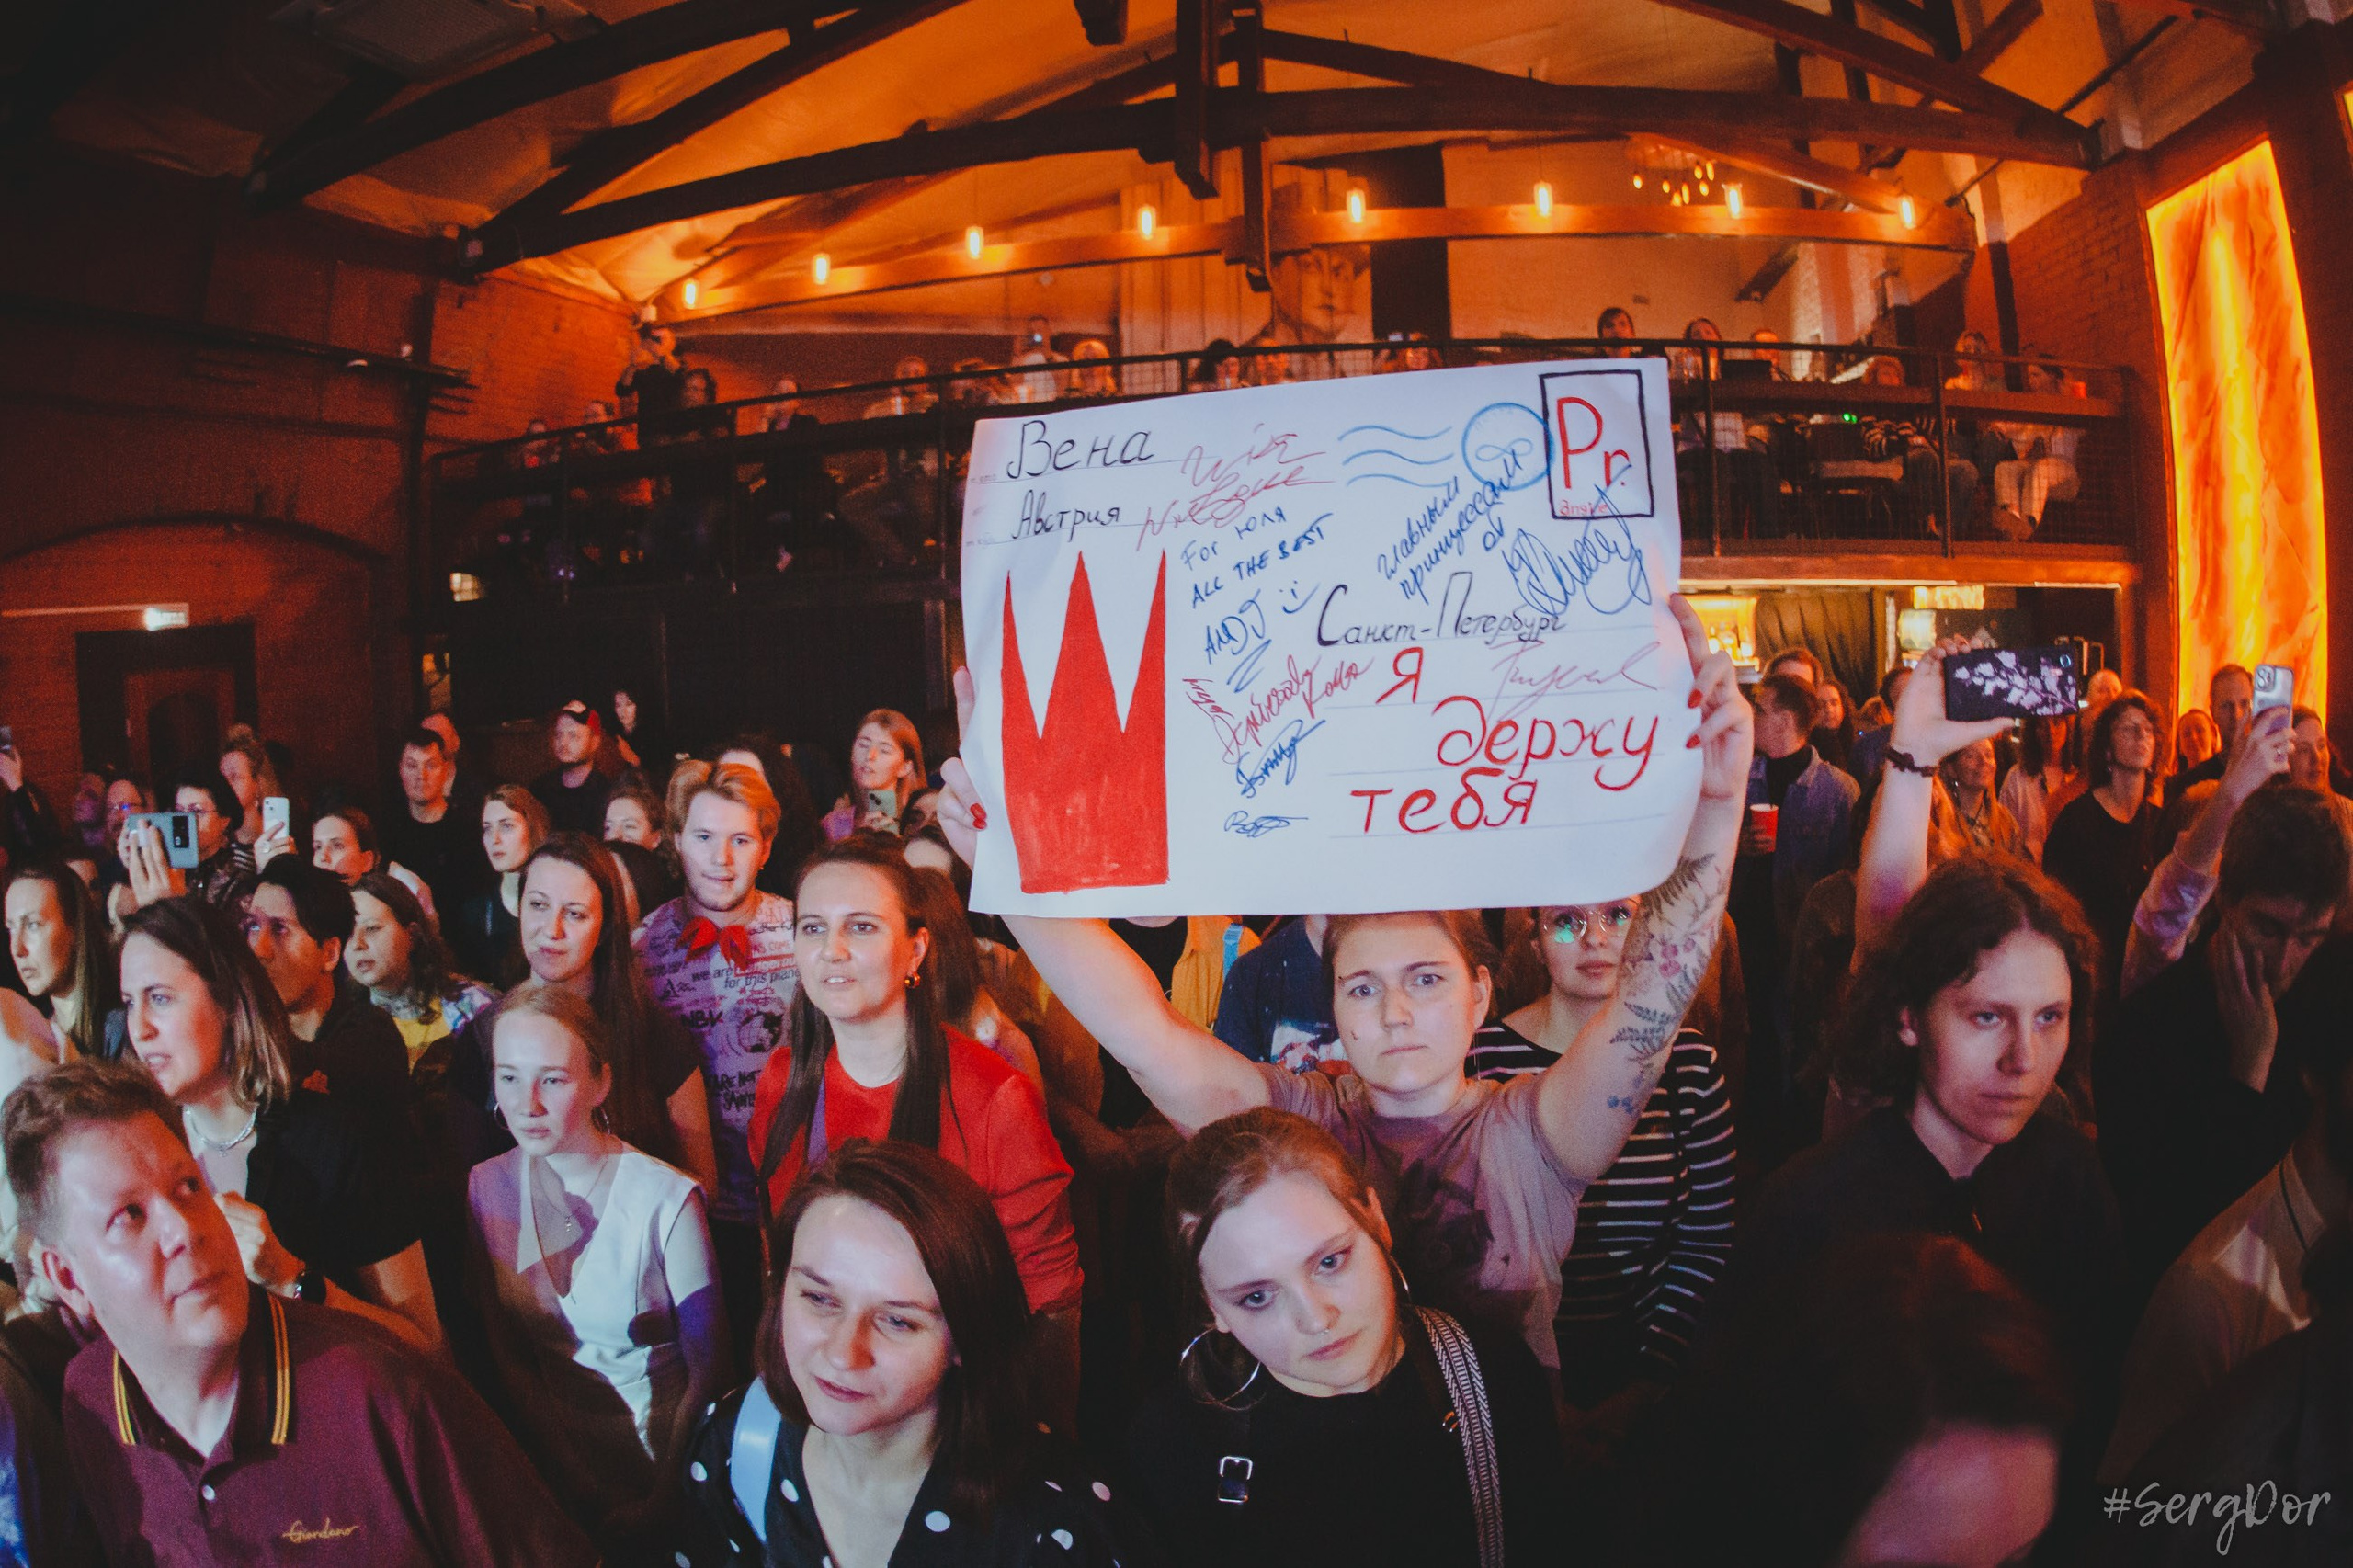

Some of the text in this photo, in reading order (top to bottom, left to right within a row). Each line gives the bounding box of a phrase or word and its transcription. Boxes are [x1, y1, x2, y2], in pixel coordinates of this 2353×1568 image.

[1007, 420, 1154, 479] Вена
[1012, 489, 1120, 542] Австрия
[1191, 574, 1225, 608] ALL
[1233, 549, 1268, 581] THE
[1317, 571, 1566, 645] Санкт-Петербург
[1375, 647, 1424, 704] Я
[1431, 695, 1658, 791] держу
[1350, 766, 1538, 834] тебя
[770, 970, 800, 983] plane
